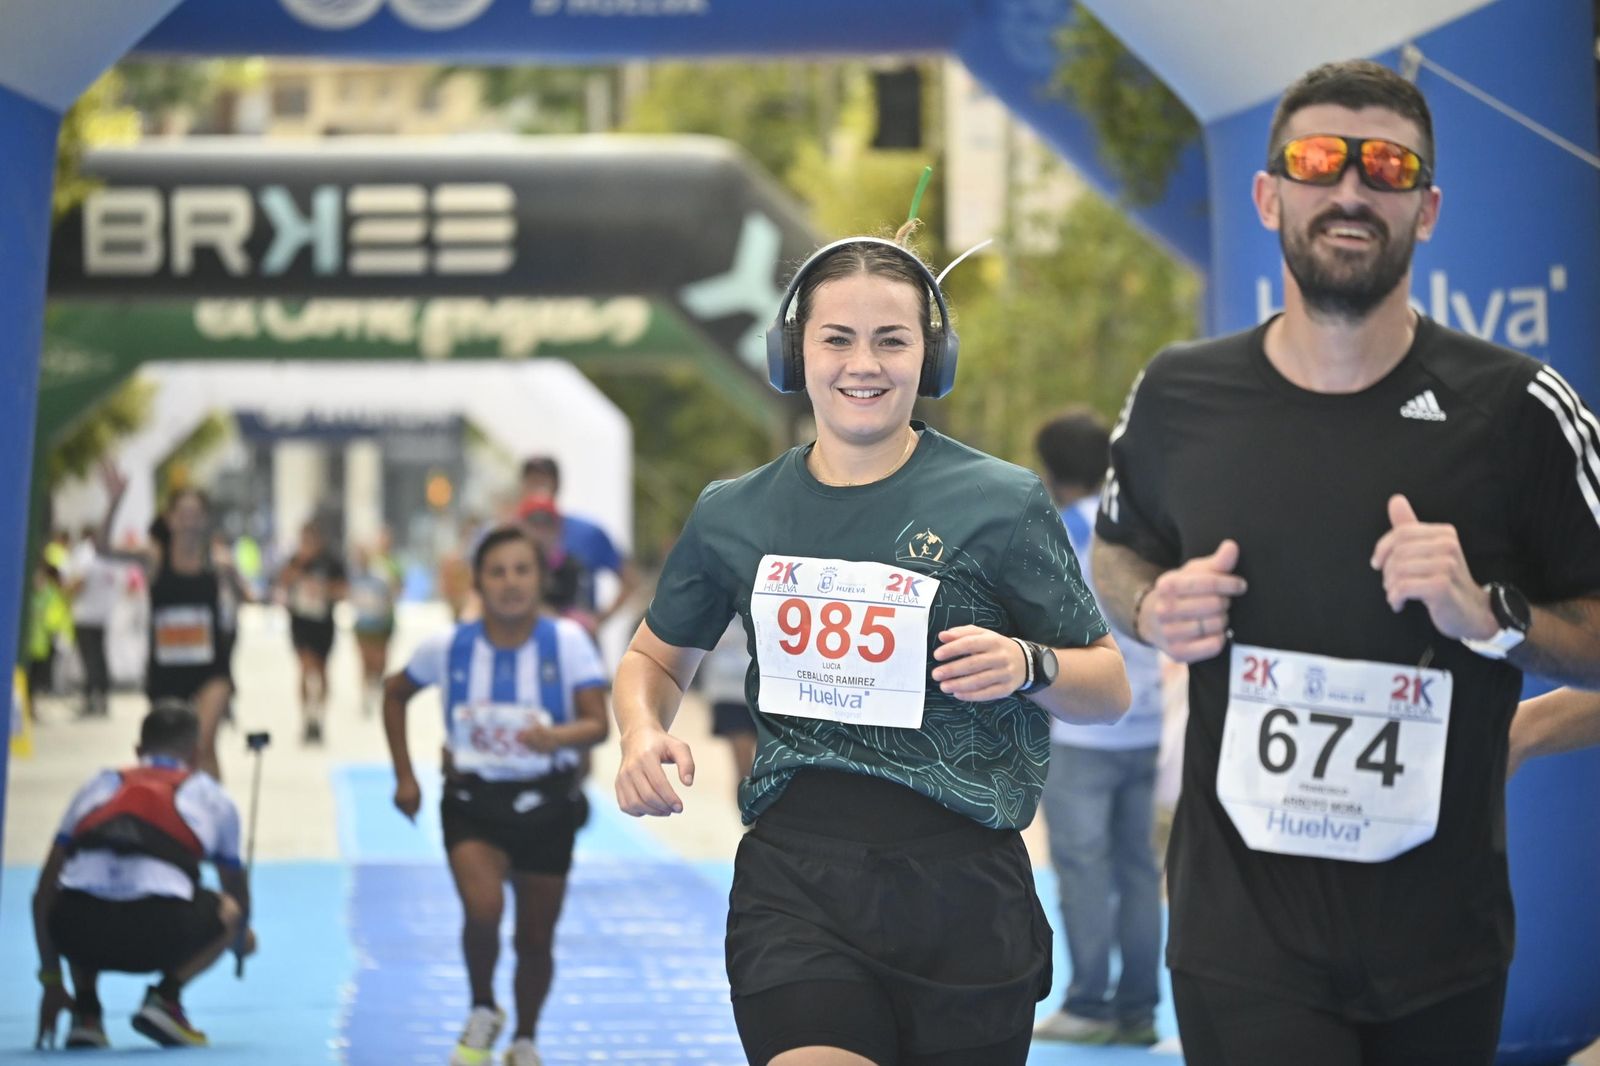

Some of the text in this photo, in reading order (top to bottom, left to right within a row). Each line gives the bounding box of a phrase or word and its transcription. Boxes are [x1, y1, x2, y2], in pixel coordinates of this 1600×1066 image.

[763, 583, 798, 594] HUELVA
[836, 586, 866, 594] HUELVA
[882, 593, 919, 605] HUELVA
[777, 598, 896, 663] 985
[822, 662, 841, 670] LUCIA
[797, 670, 875, 687] CEBALLOS RAMIREZ
[799, 682, 863, 709] Huelva
[1258, 707, 1404, 788] 674
[1267, 808, 1361, 843] Huelva
